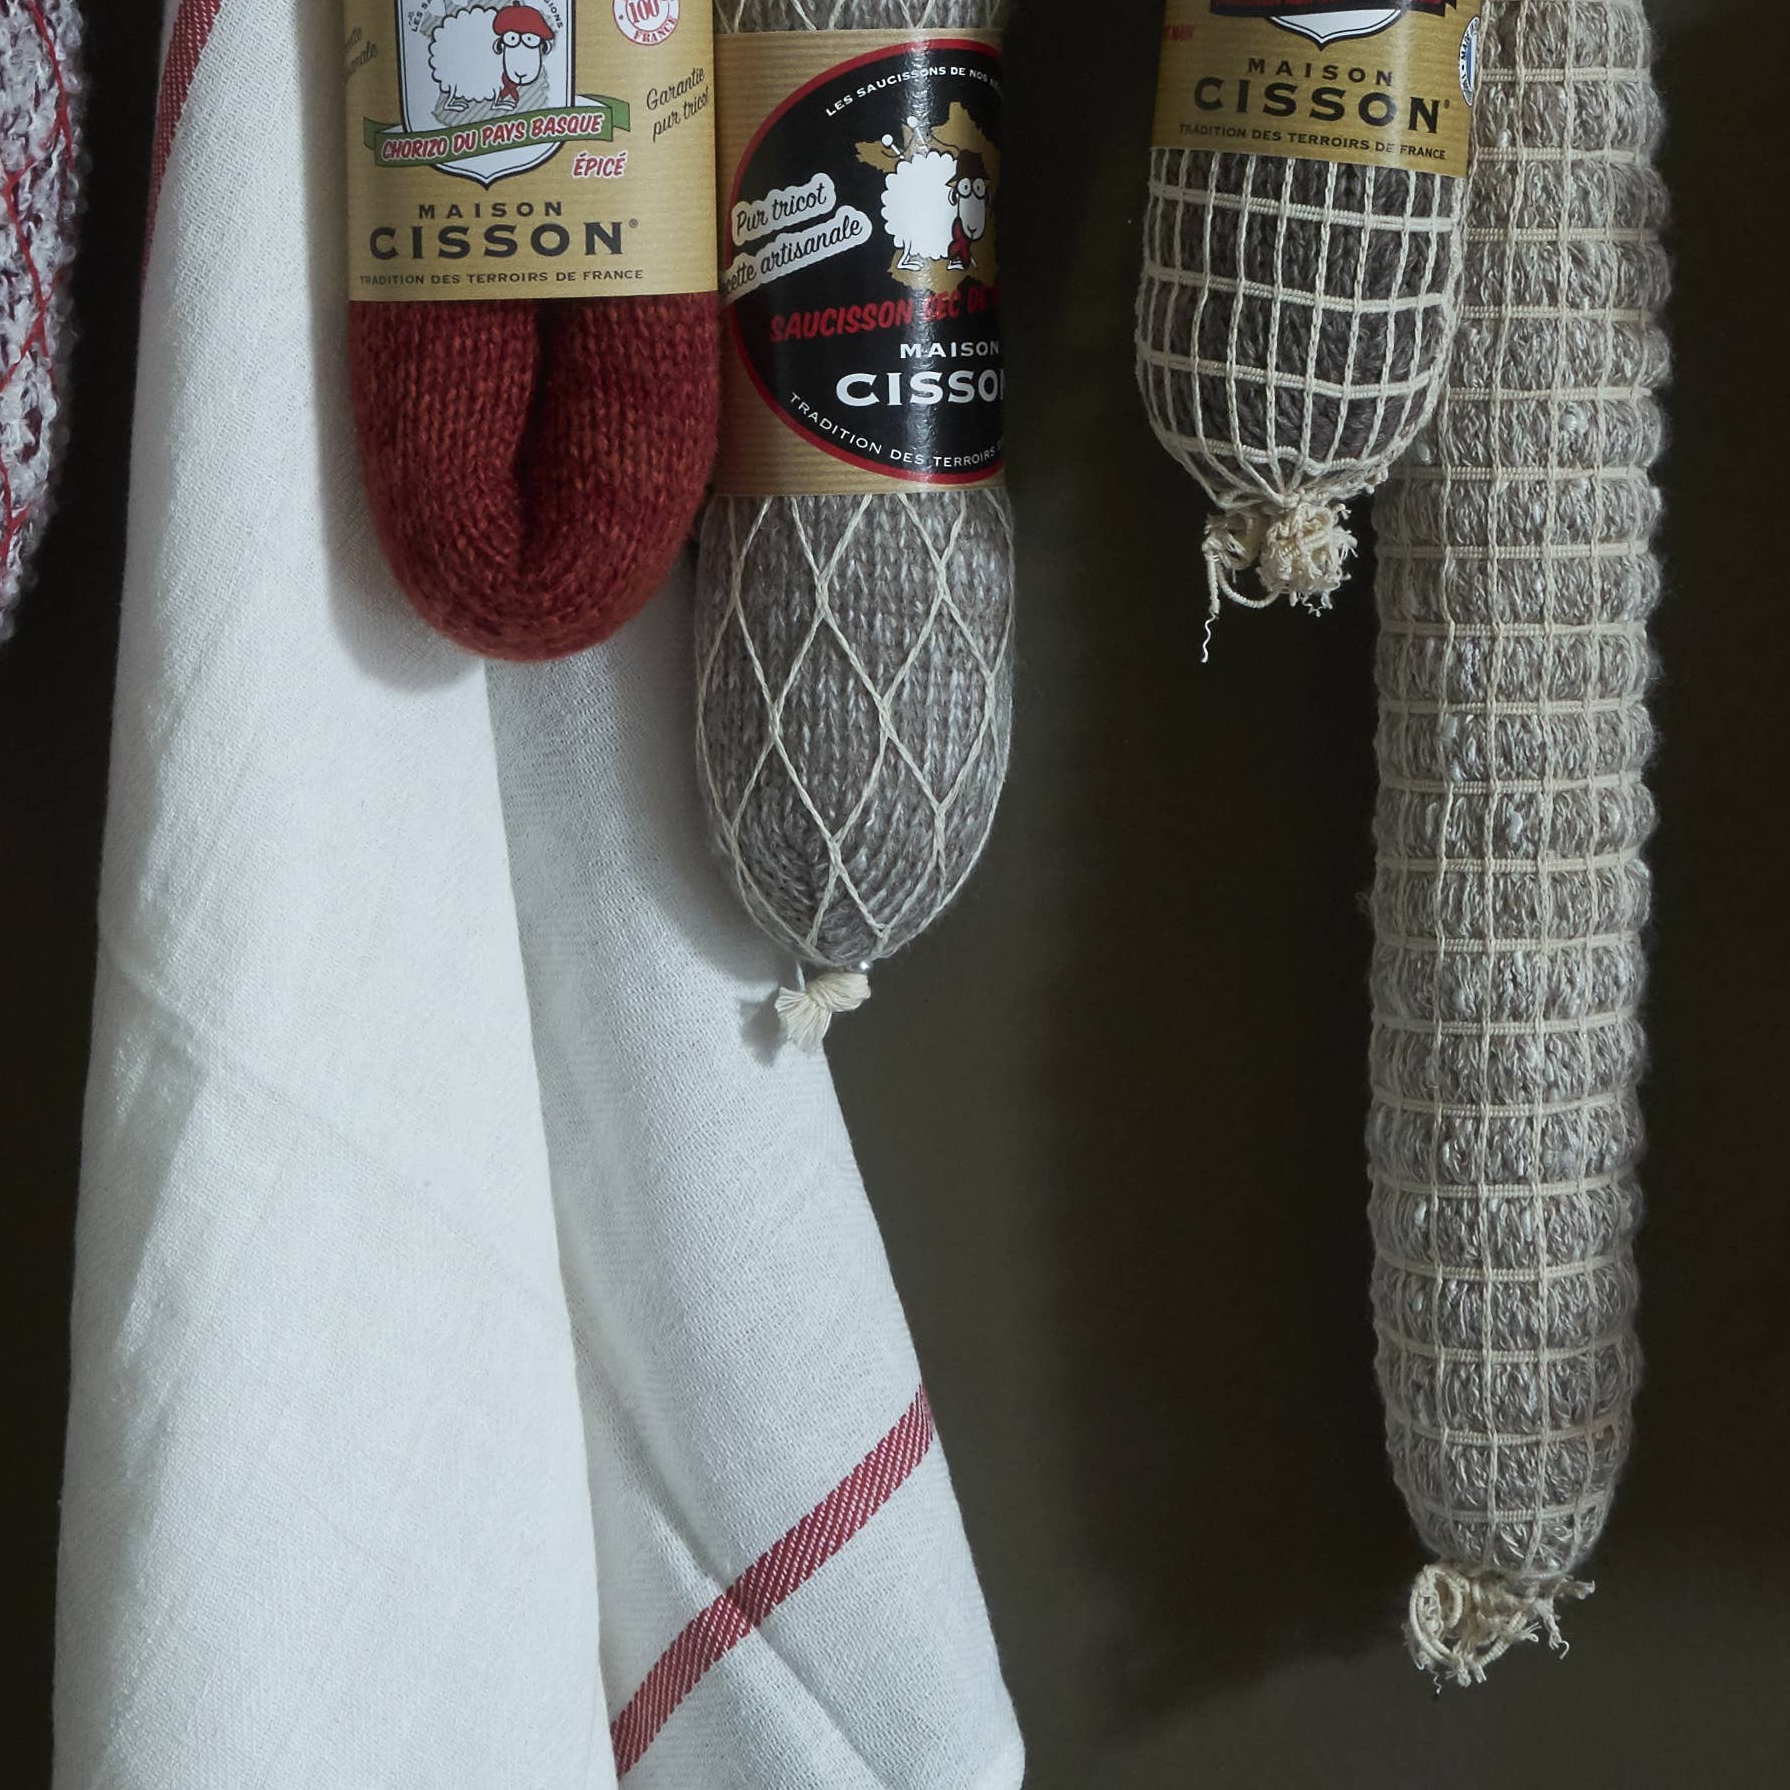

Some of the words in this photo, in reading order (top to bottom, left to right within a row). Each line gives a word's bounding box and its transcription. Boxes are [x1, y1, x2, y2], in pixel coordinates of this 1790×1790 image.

[410, 9, 424, 33] LES
[633, 16, 678, 44] FRANCE
[646, 66, 705, 111] Garantie
[1247, 57, 1394, 88] MAISON
[825, 94, 855, 118] LES
[856, 66, 947, 98] SAUCISSONS
[950, 66, 967, 77] DE
[969, 68, 989, 84] NOS
[381, 136, 448, 160] CHORIZO
[451, 131, 476, 152] DU
[481, 124, 526, 147] PAYS
[530, 113, 604, 140] BASQUE
[652, 112, 682, 144] pur
[1179, 123, 1247, 141] TRADITION
[1252, 129, 1283, 142] DES
[1287, 132, 1371, 151] TERROIRS
[1374, 141, 1395, 154] DE
[1399, 144, 1447, 161] FRANCE
[572, 151, 629, 178] ÉPICÉ
[418, 201, 563, 220] MAISON
[736, 209, 769, 237] Pur
[772, 182, 828, 221] tricot
[760, 214, 863, 275] artisanale
[359, 274, 424, 286] TRADITION
[430, 272, 460, 285] DES
[466, 270, 548, 284] TERROIRS
[556, 270, 576, 283] DE
[582, 268, 645, 281] FRANCE
[770, 296, 914, 344] SAUCISSON
[900, 341, 1001, 359] MAISON
[788, 391, 883, 455] TRADITION
[889, 448, 924, 465] DES
[933, 448, 996, 468] TERROIRS
